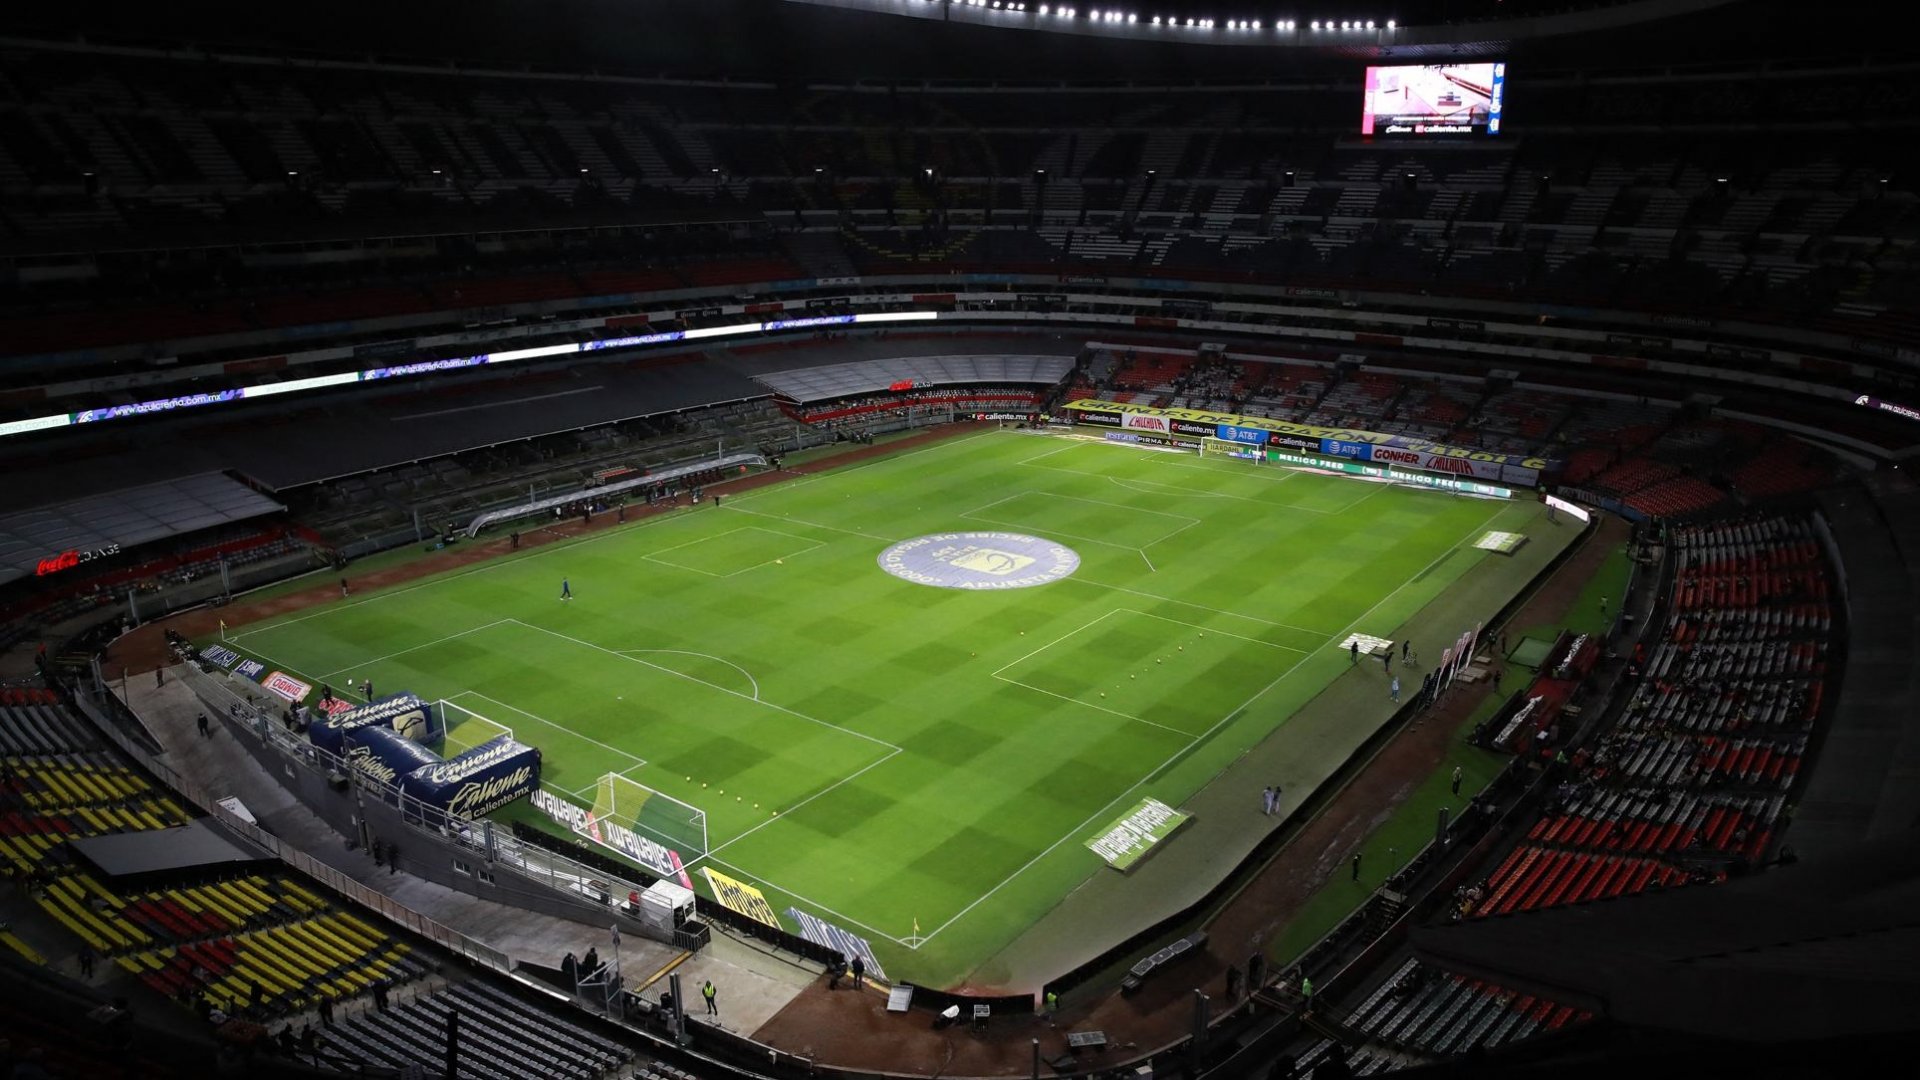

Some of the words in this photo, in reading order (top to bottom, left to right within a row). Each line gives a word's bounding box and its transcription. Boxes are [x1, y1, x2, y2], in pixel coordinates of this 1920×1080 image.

[114, 394, 222, 415] www.azulcrema.com.mx
[985, 413, 1027, 421] caliente.mx
[1085, 413, 1120, 424] caliente.mx
[1178, 423, 1216, 436] caliente.mx
[1238, 432, 1258, 440] AT&T
[1138, 436, 1163, 445] PIRMA
[1279, 438, 1319, 449] caliente.mx
[1341, 445, 1362, 455] AT&T
[1374, 449, 1420, 464] GONHER
[1279, 454, 1317, 466] MEXICO
[1391, 471, 1431, 483] MEXICO
[272, 678, 302, 697] BIMBO
[328, 696, 408, 729] Caliente
[432, 742, 513, 783] Caliente
[446, 766, 531, 818] Caliente
[473, 785, 530, 818] caliente.mx
[603, 820, 674, 874] caliente.mx
